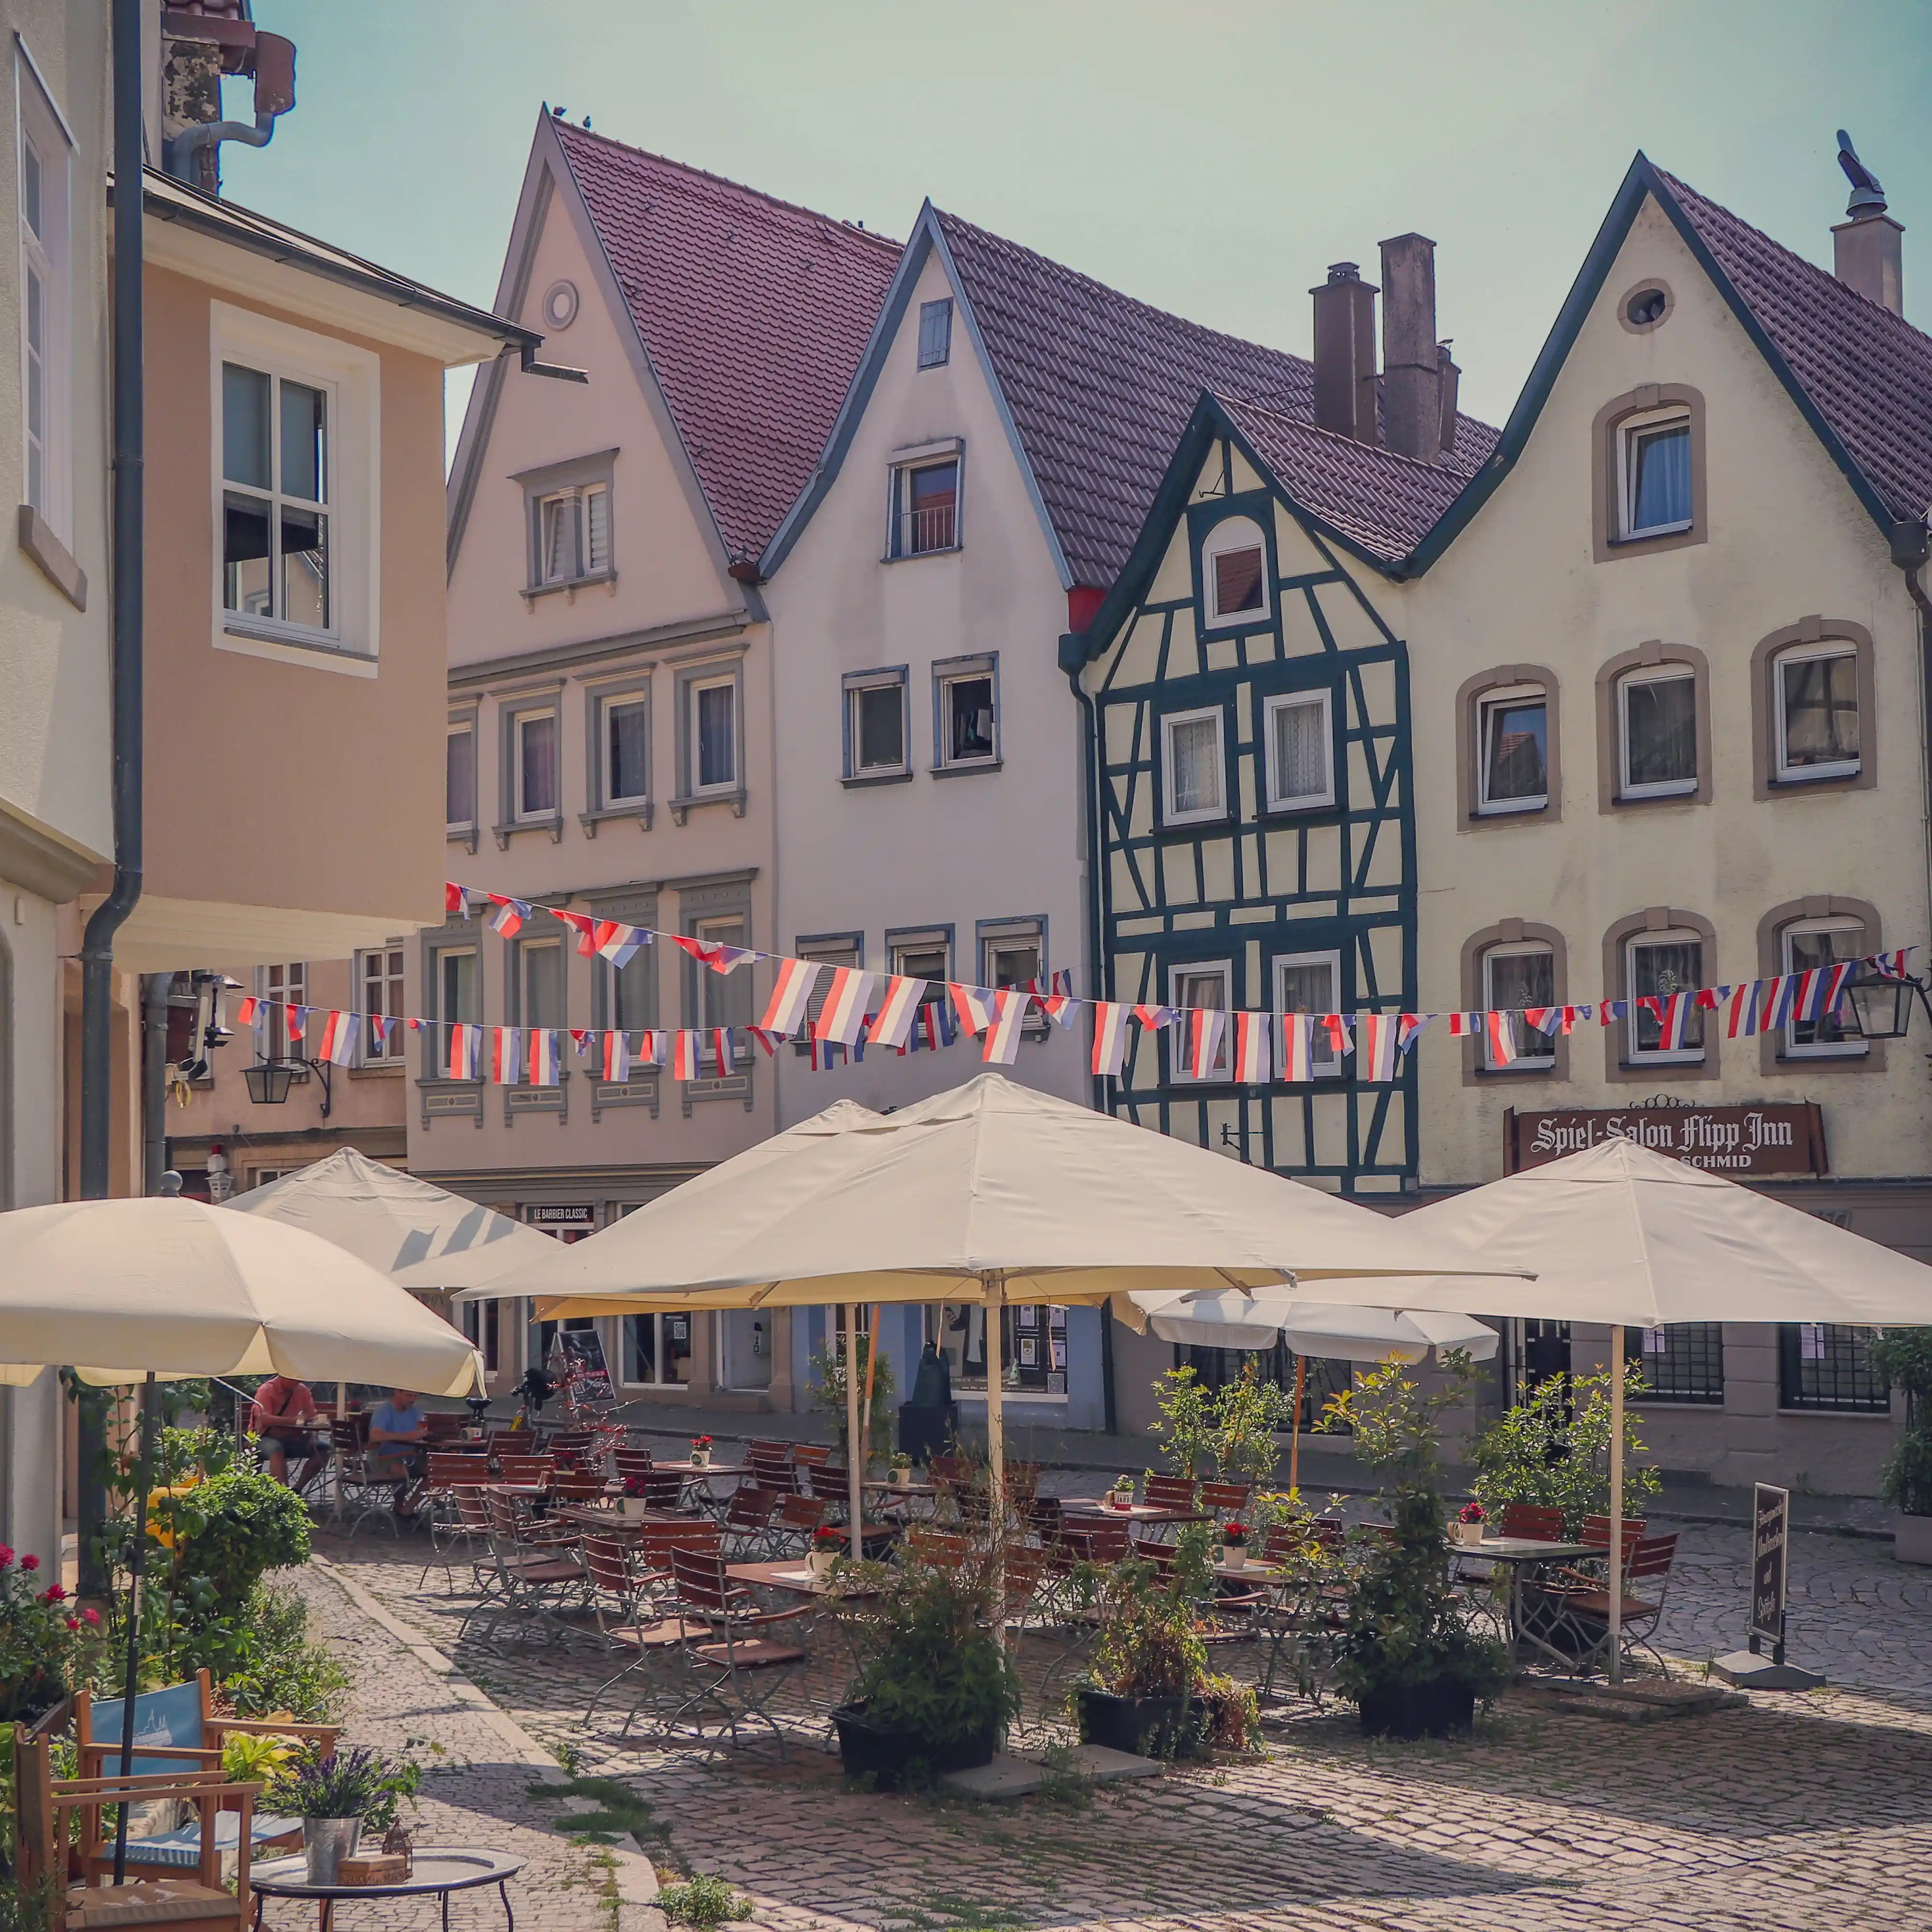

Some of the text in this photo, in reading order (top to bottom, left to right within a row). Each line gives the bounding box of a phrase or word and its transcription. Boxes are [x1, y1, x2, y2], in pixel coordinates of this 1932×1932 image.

[1676, 1114, 1739, 1153] Flipp
[1742, 1112, 1793, 1151] Inn
[1680, 1155, 1751, 1167] SCHMID
[535, 1208, 587, 1219] LE BARBIER CLASSIC
